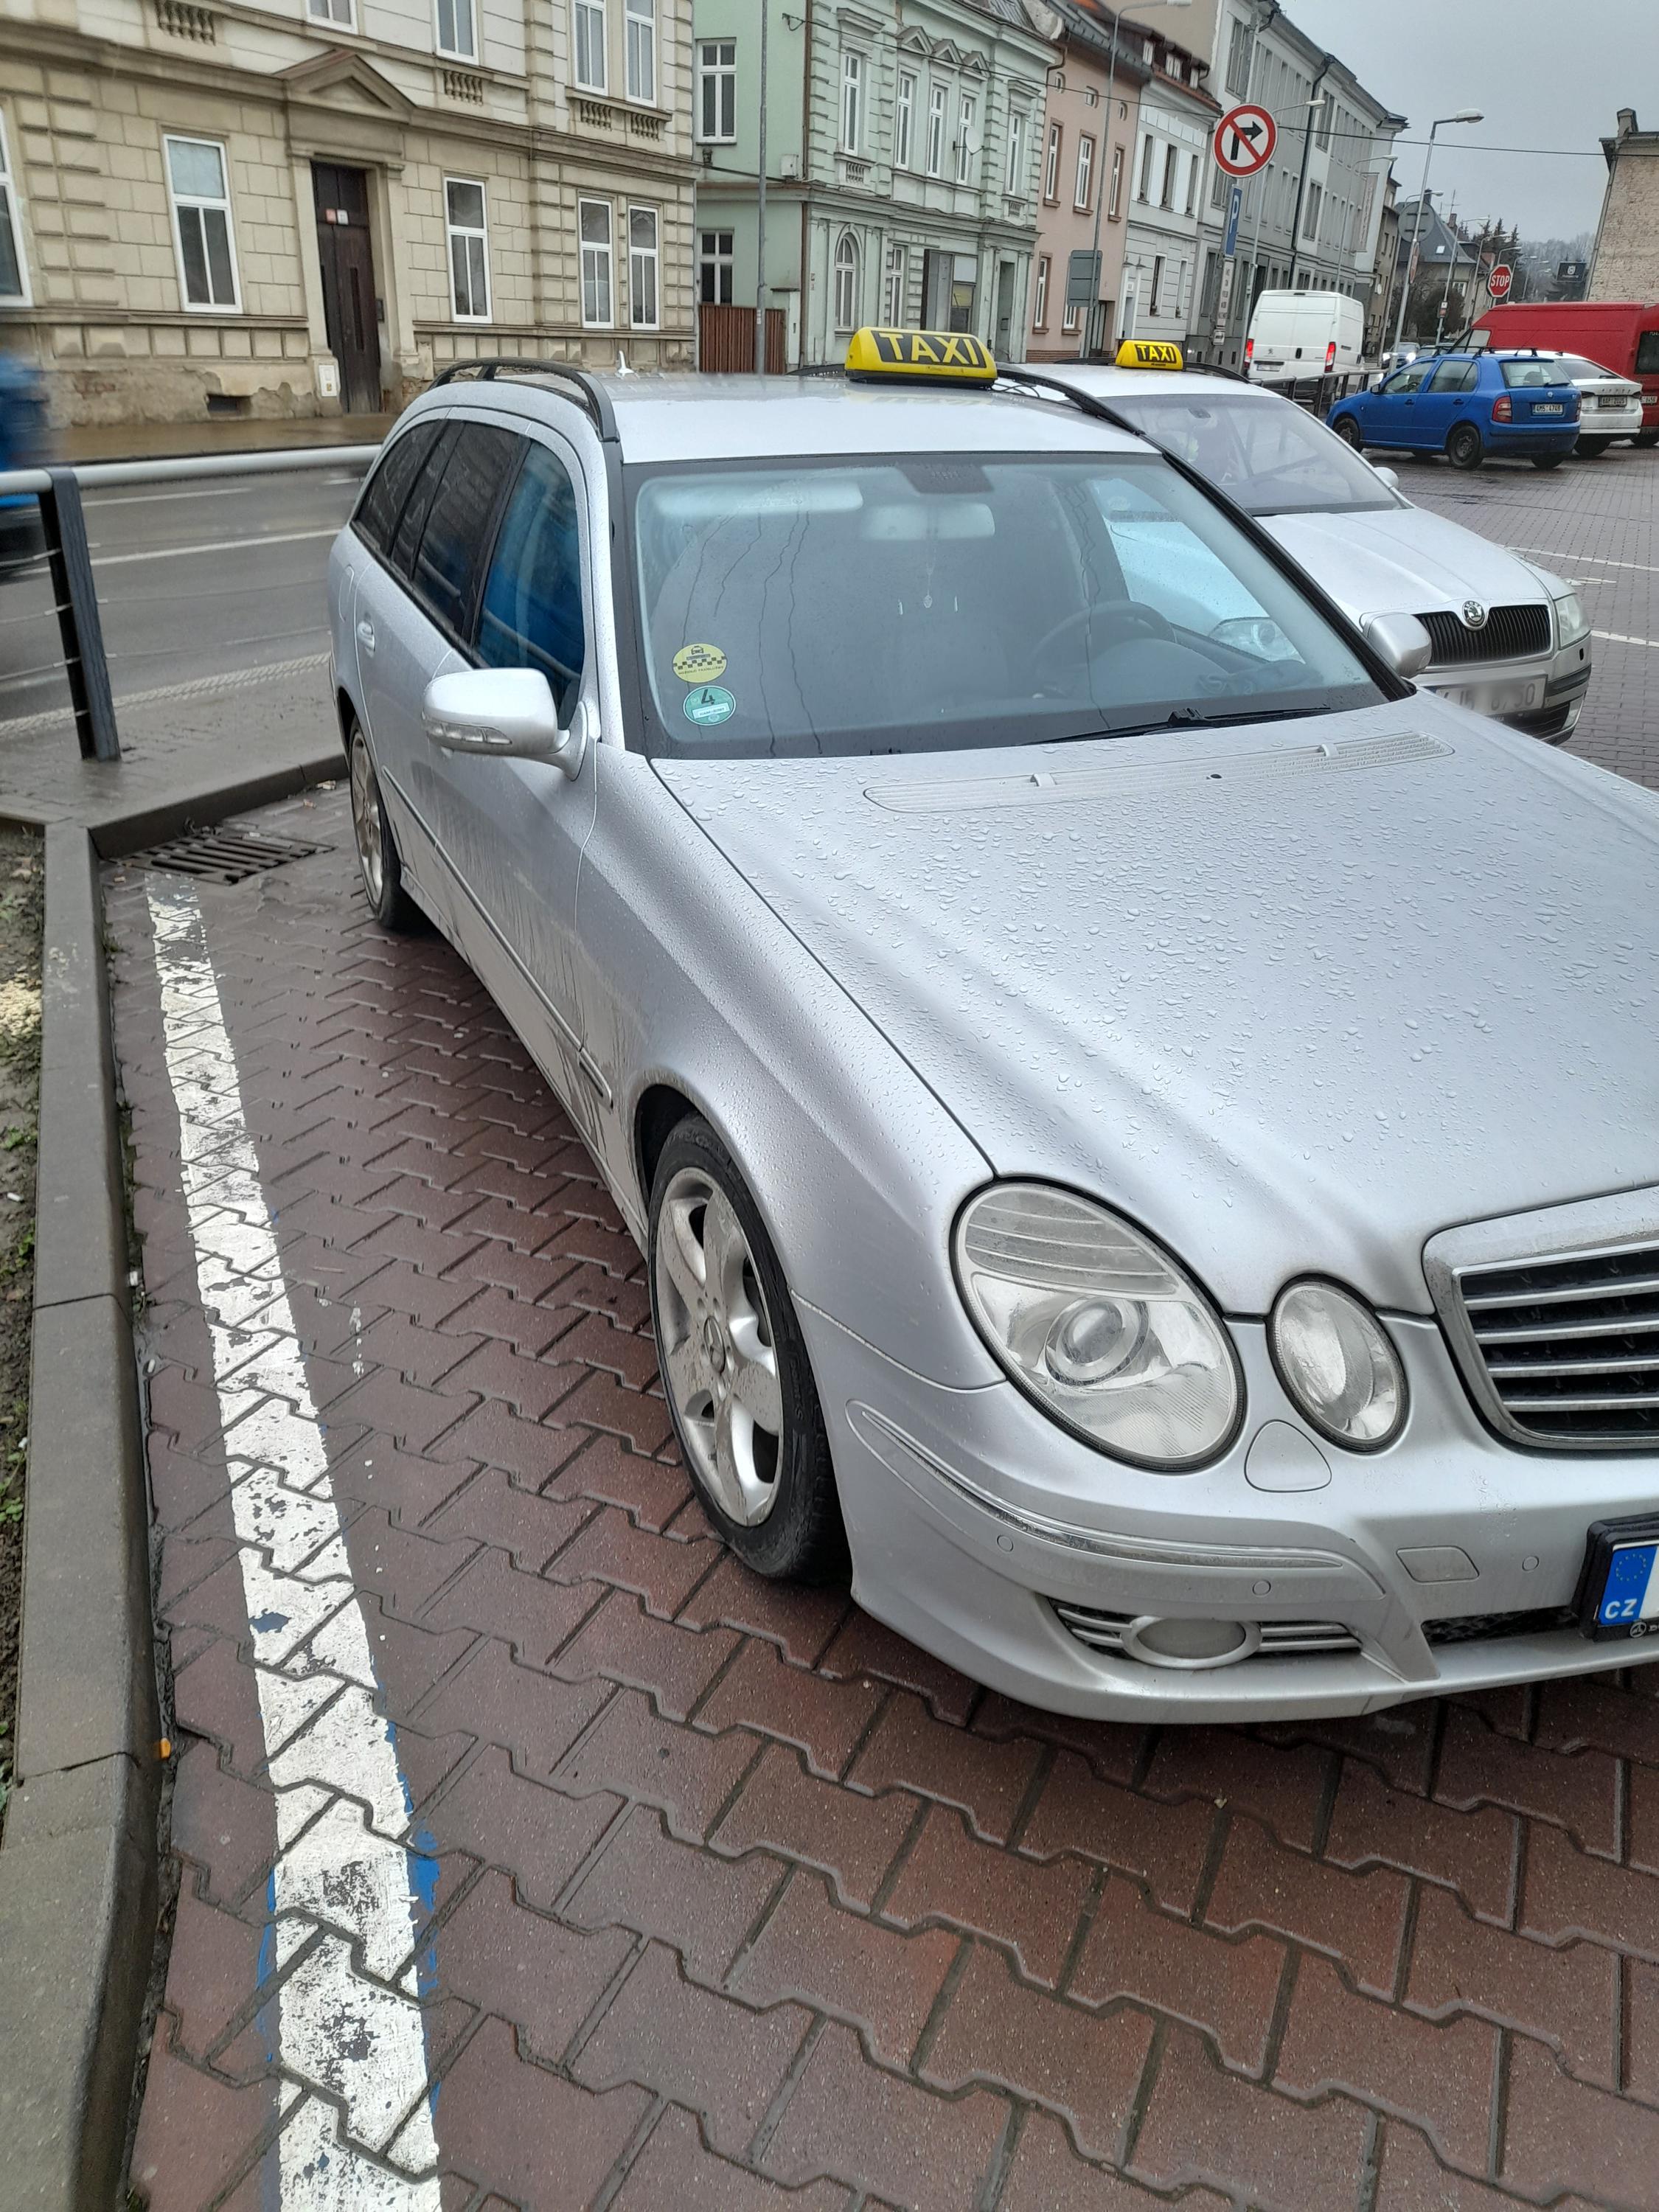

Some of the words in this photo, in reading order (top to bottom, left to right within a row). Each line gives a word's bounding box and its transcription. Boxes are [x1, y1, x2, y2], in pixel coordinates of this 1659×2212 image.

[1229, 195, 1239, 234] P
[1490, 274, 1510, 287] STOP
[878, 332, 979, 366] TAXI
[1136, 345, 1175, 362] TAXI
[701, 689, 715, 705] 4
[1604, 1598, 1638, 1619] CZ
